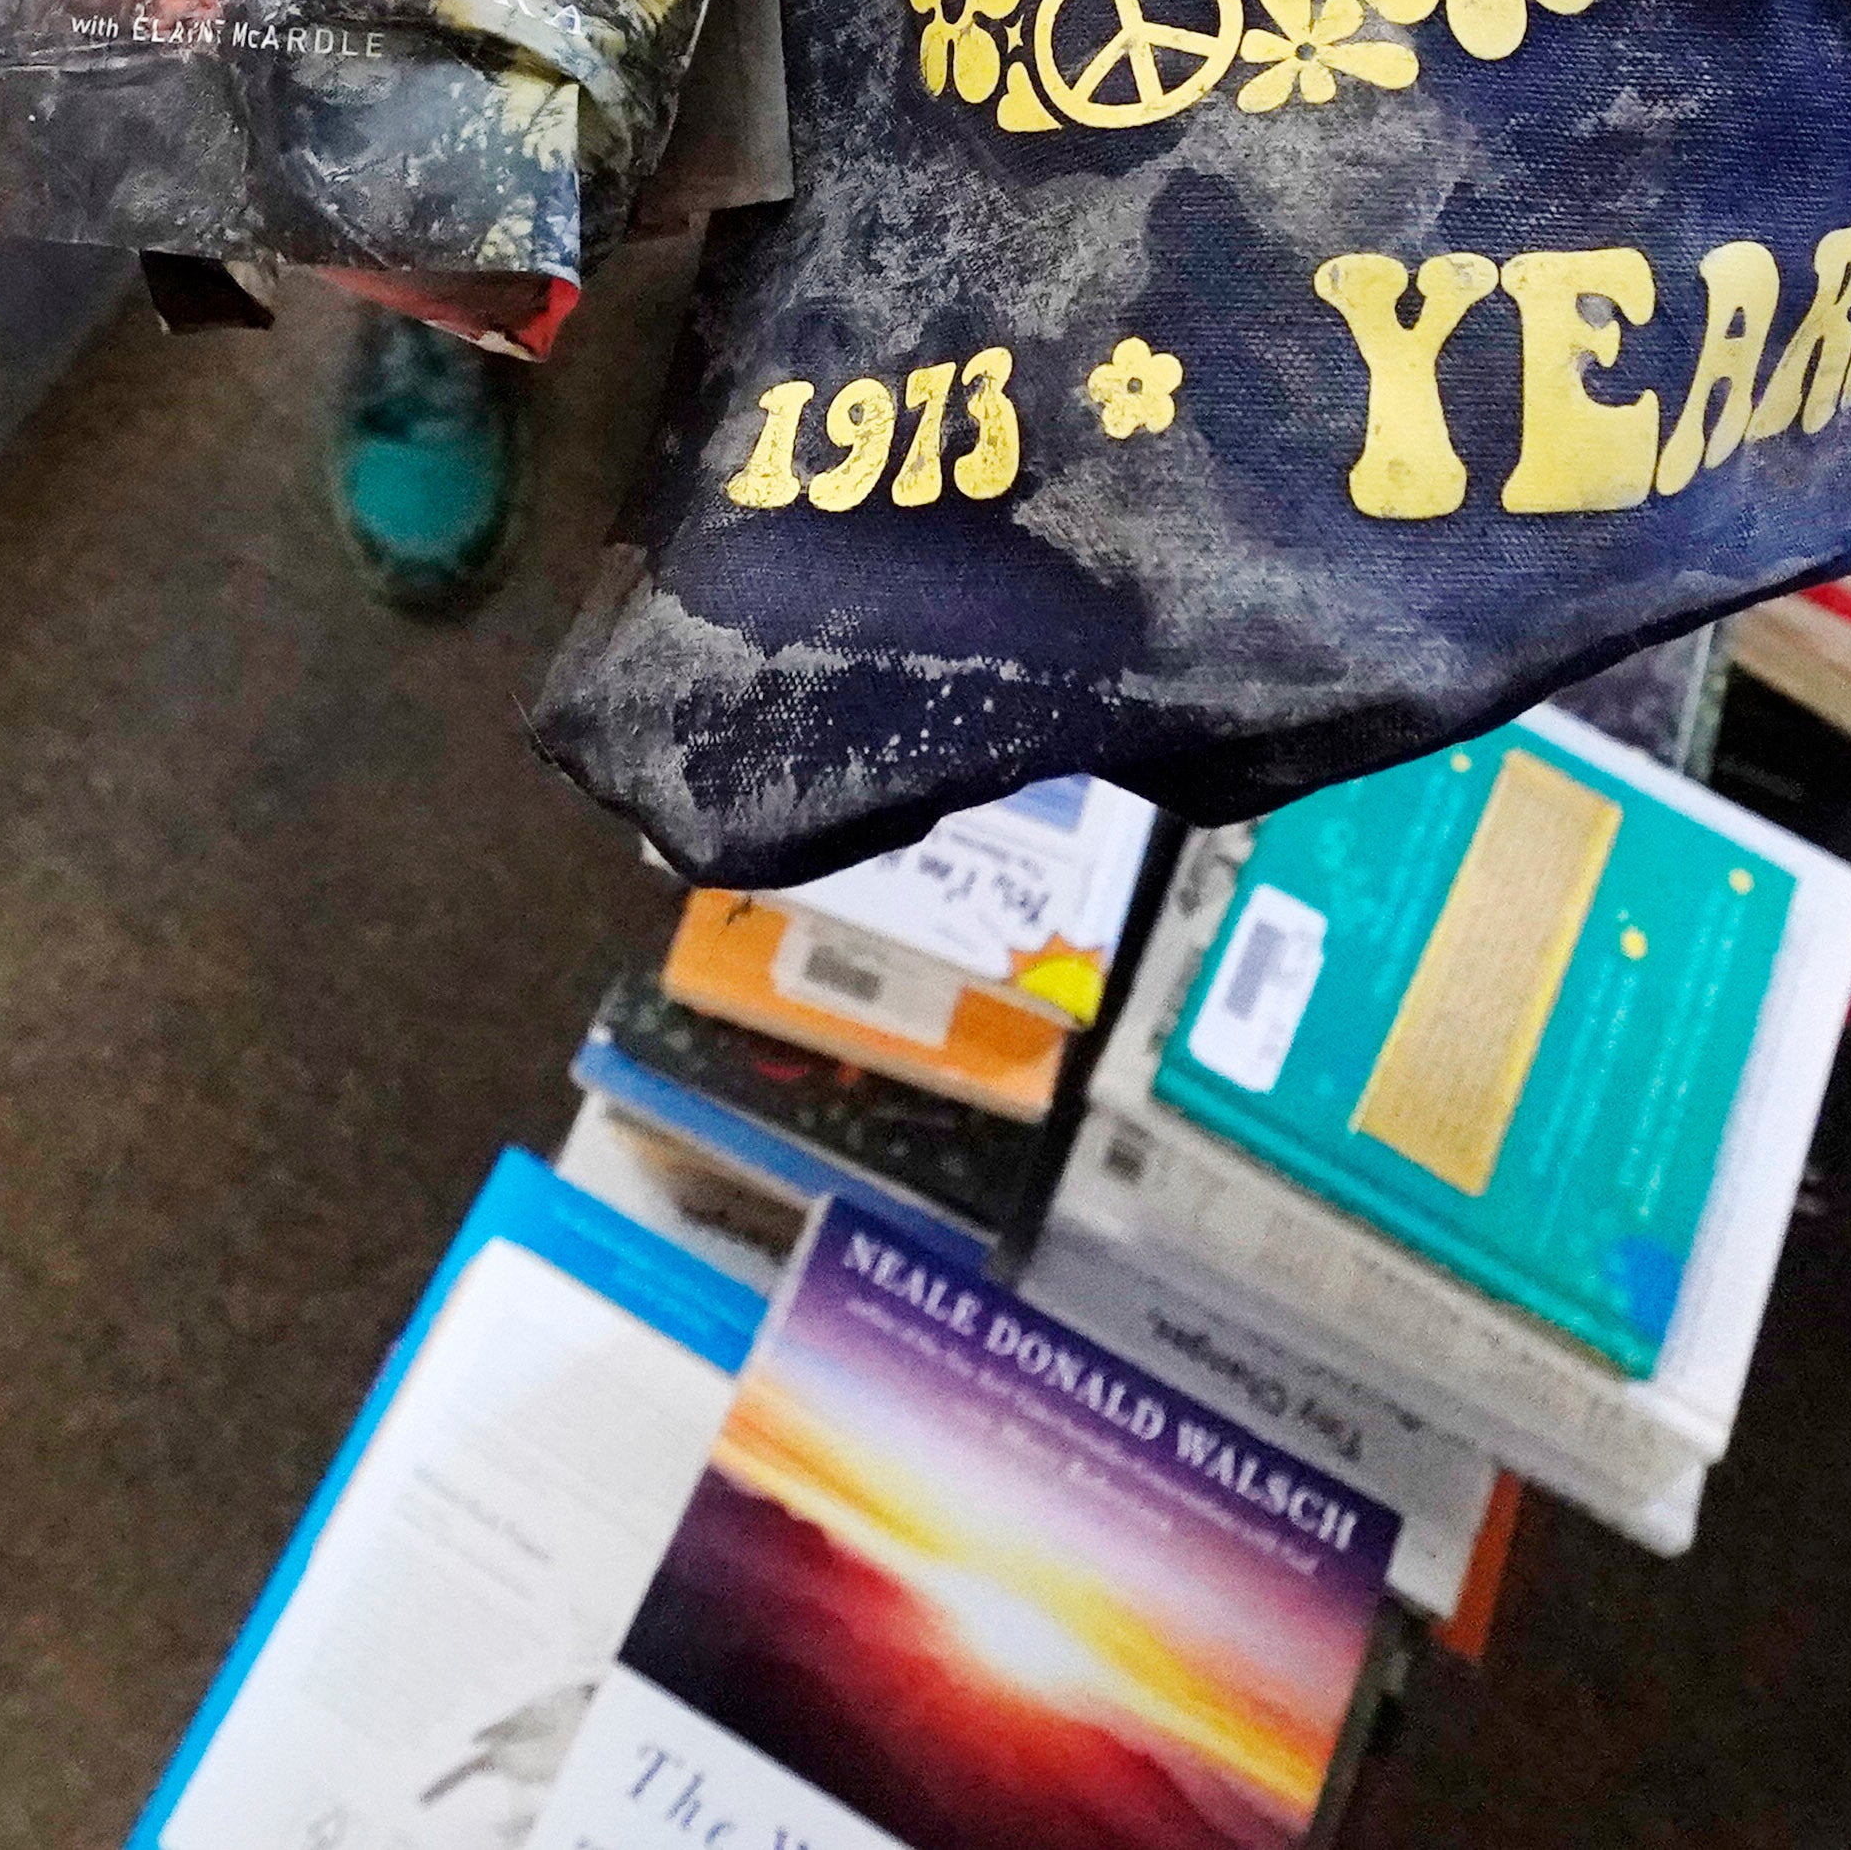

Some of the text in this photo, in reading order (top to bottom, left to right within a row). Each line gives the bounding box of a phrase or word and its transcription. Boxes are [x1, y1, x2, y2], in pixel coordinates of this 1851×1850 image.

[70, 14, 120, 39] with
[231, 21, 387, 59] McARDLE
[728, 346, 1026, 513] 1973
[843, 1233, 978, 1337] NEALE
[984, 1297, 1167, 1443] DONALD
[1175, 1418, 1360, 1551] WALSCH
